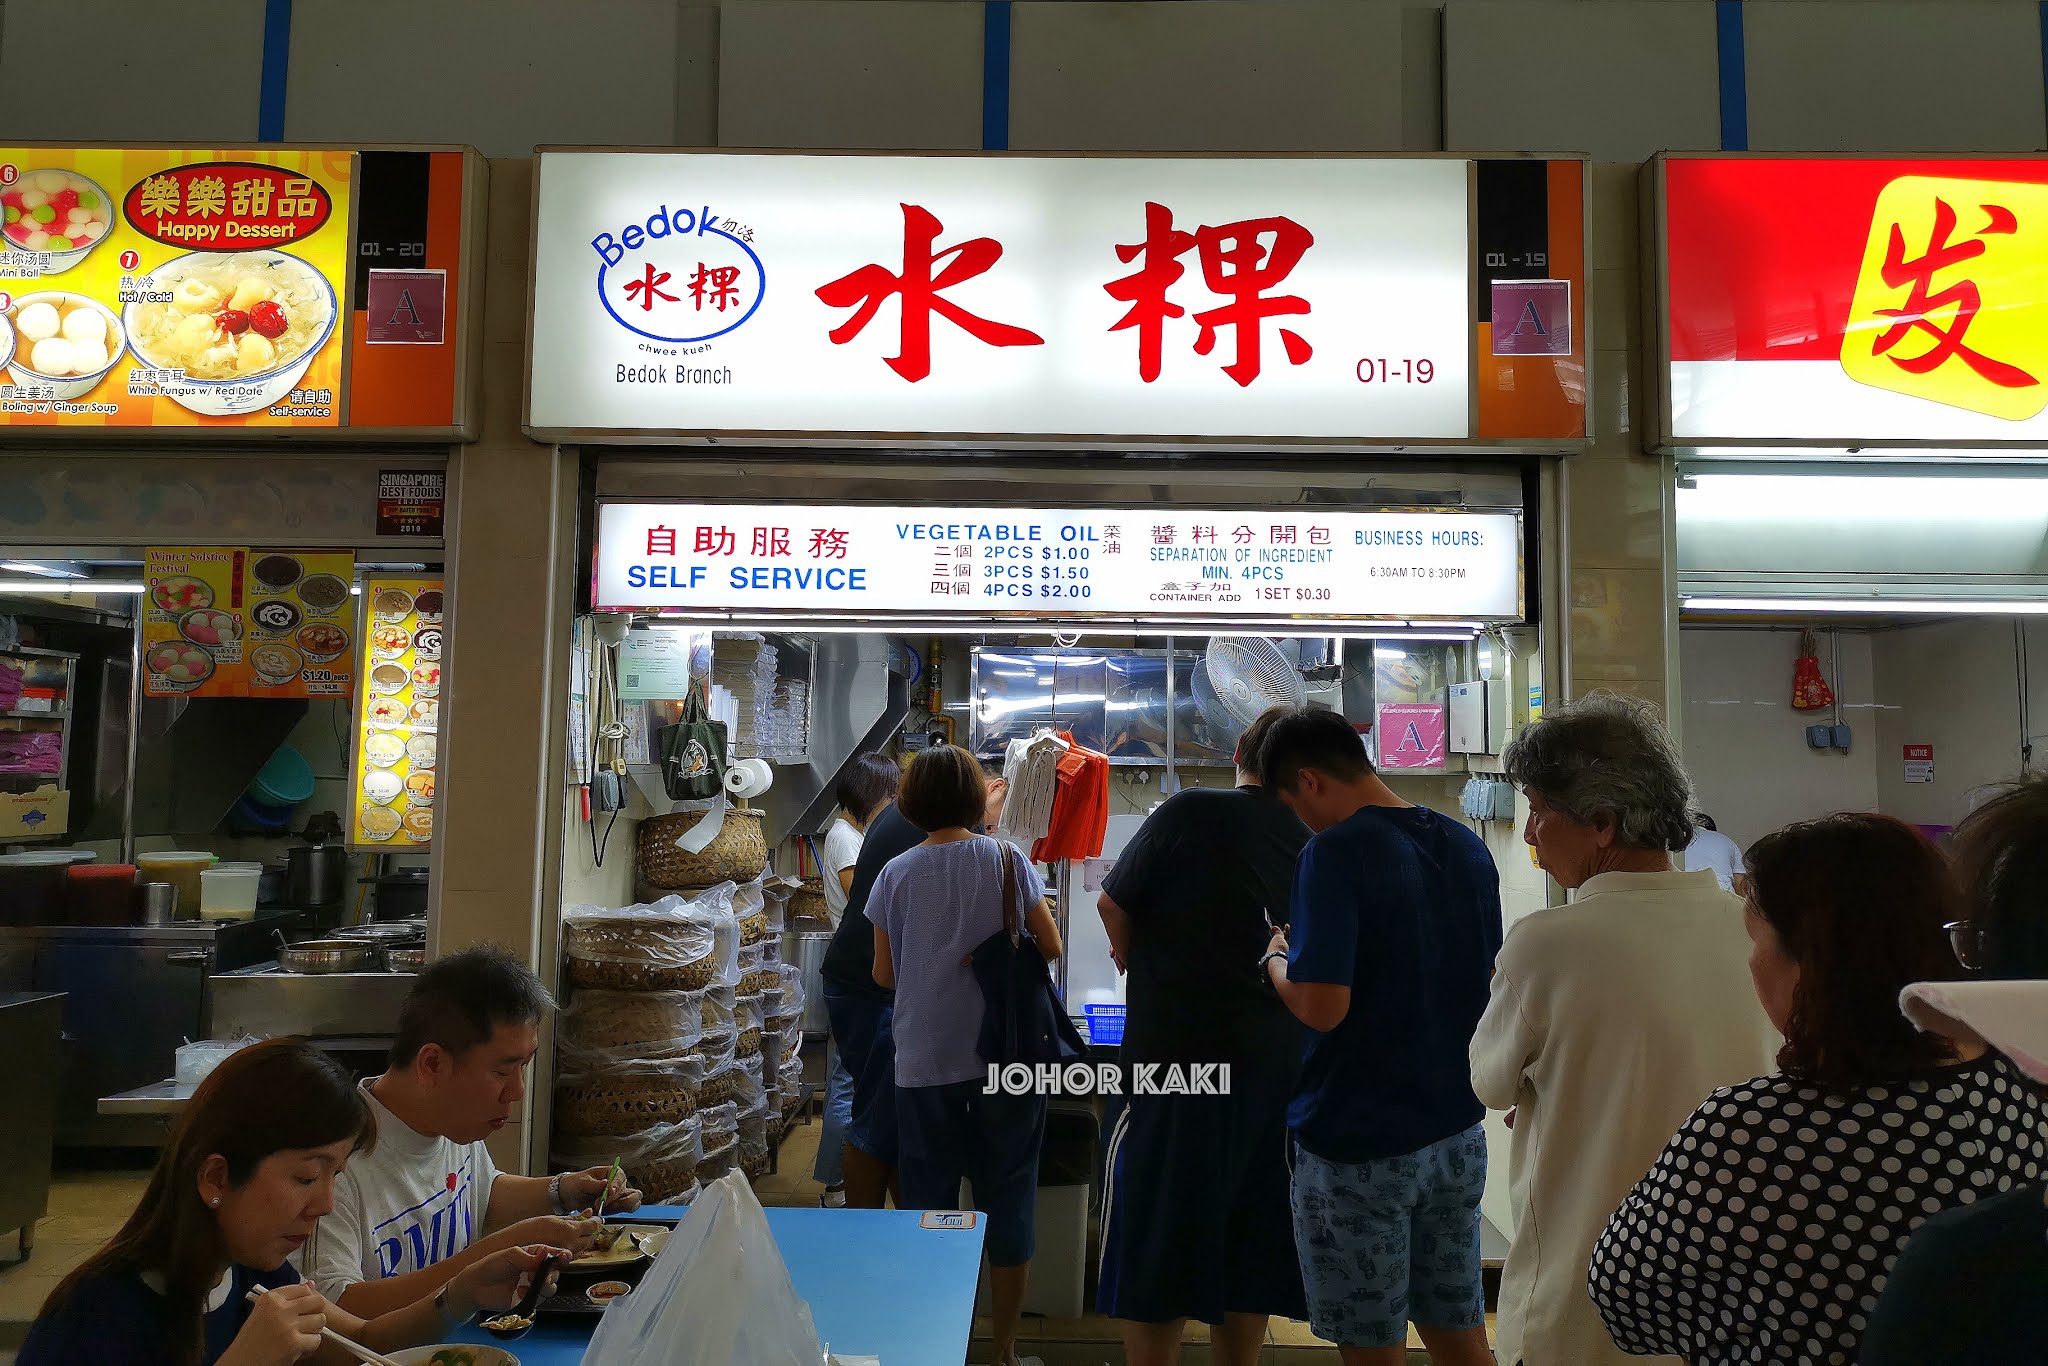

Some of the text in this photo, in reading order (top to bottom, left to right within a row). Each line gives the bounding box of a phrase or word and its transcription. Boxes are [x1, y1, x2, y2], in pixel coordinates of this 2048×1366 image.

[4, 168, 13, 182] 6
[141, 174, 318, 219] 樂樂甜品
[157, 221, 296, 241] Happy Dessert
[590, 204, 720, 268] Bedok
[722, 217, 755, 244] 勿洛
[0, 251, 51, 266] 迷你汤圆
[125, 254, 133, 267] 7
[20, 268, 39, 277] Ball
[623, 262, 741, 312] 水粿
[1871, 195, 2041, 388] 发
[119, 291, 138, 303] Hot
[147, 291, 174, 303] Cold
[814, 202, 1314, 388] 水粿
[386, 287, 425, 325] A
[1511, 298, 1549, 336] A
[638, 342, 712, 356] chwee kueh
[129, 369, 185, 383] 红枣雪耳
[616, 363, 732, 384] Bedok Branch
[1356, 358, 1434, 384] 01-19
[1, 385, 55, 399] 圆生姜汤
[129, 386, 264, 397] White Fungus w/ Red Date
[290, 389, 331, 405] 请自助
[2, 402, 33, 412] Boling
[53, 402, 89, 413] Ginger
[91, 402, 117, 413] Soup
[269, 406, 331, 417] Self-service
[380, 473, 444, 487] SINGAPORE
[381, 487, 441, 498] BEST FOODS
[400, 525, 421, 533] 2019
[896, 523, 1100, 541] VEGETABLE OIL
[1150, 525, 1332, 545] 醬料分開包
[645, 524, 850, 560] 自助服務
[1355, 530, 1484, 546] BUSINESS HOURS:
[151, 552, 229, 561] Winter Solstice
[934, 544, 1090, 561] 二個 2PCS $1.00
[1150, 547, 1333, 563] SEPARATION OF INGREDIENT
[150, 564, 189, 573] Festival
[932, 563, 1089, 580] 三個 3PCS $1.50
[1202, 566, 1284, 580] MIN. 4PCS
[1370, 567, 1466, 578] 6:30AM TO 8:30PM
[628, 565, 867, 591] SELF SERVICE
[930, 581, 1091, 599] 四個 4PCS $2.00
[1149, 593, 1241, 602] CONTAINER ADD
[1296, 588, 1331, 601] $0.30
[302, 670, 331, 681] $1.20
[1395, 720, 1429, 752] A
[1910, 748, 1928, 757] NOTICE
